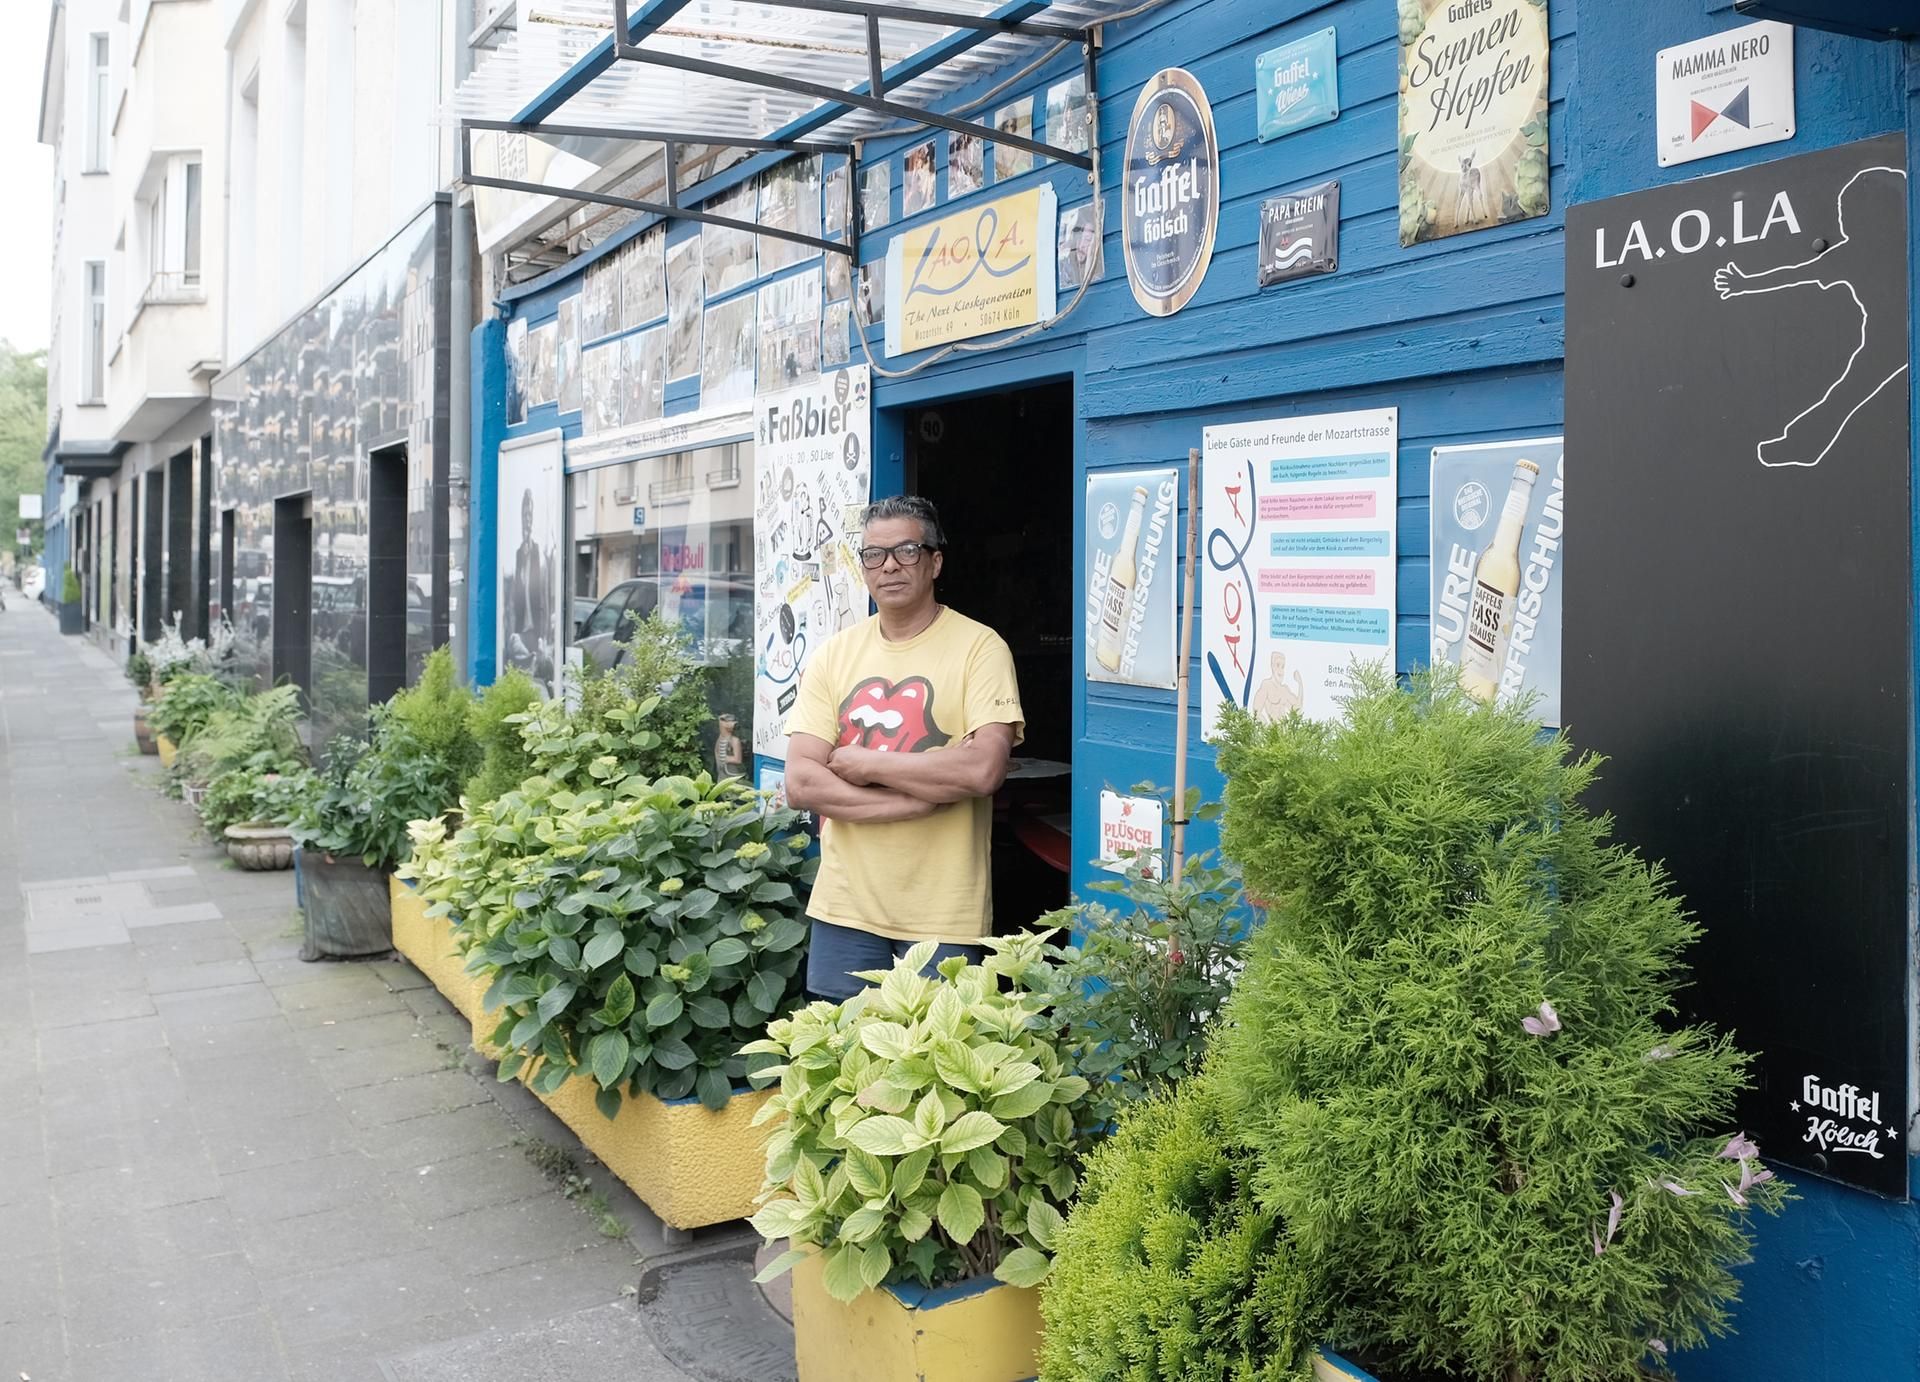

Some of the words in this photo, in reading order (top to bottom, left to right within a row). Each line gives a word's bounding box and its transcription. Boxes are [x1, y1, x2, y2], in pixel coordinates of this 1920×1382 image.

[1410, 8, 1523, 88] Sonnen
[1672, 47, 1726, 81] MAMMA
[1731, 34, 1770, 64] NERO
[1273, 56, 1310, 88] Gaffel
[1428, 49, 1535, 132] Hopfen
[1134, 156, 1201, 218] Gaffel
[1268, 203, 1291, 224] PAPA
[1294, 194, 1324, 218] RHEIN
[1143, 209, 1189, 244] Kölsch
[905, 311, 925, 327] The
[926, 306, 951, 323] Next
[953, 287, 1033, 314] Kioskgeneration
[1003, 308, 1021, 322] Köln
[768, 395, 852, 445] Faßbier
[1207, 438, 1229, 450] Liebe
[1229, 436, 1252, 449] Gäste
[1253, 434, 1270, 447] und
[1271, 431, 1306, 445] Freunde
[1308, 429, 1323, 442] der
[1325, 425, 1391, 441] Mozartstrasse
[817, 470, 840, 521] Mühlen
[684, 543, 704, 569] Bull
[1120, 480, 1175, 680] ERFRISCHUNG
[1105, 591, 1124, 616] FASS
[1475, 586, 1504, 611] GAFFELS
[1471, 600, 1501, 632] FASS
[1469, 621, 1497, 647] BRAUSE
[1324, 678, 1338, 689] den
[1328, 664, 1345, 675] Bitte
[1104, 820, 1153, 846] PLÜSCH
[1803, 1074, 1883, 1126] Gaffel
[1802, 1116, 1885, 1160] Kölsch
